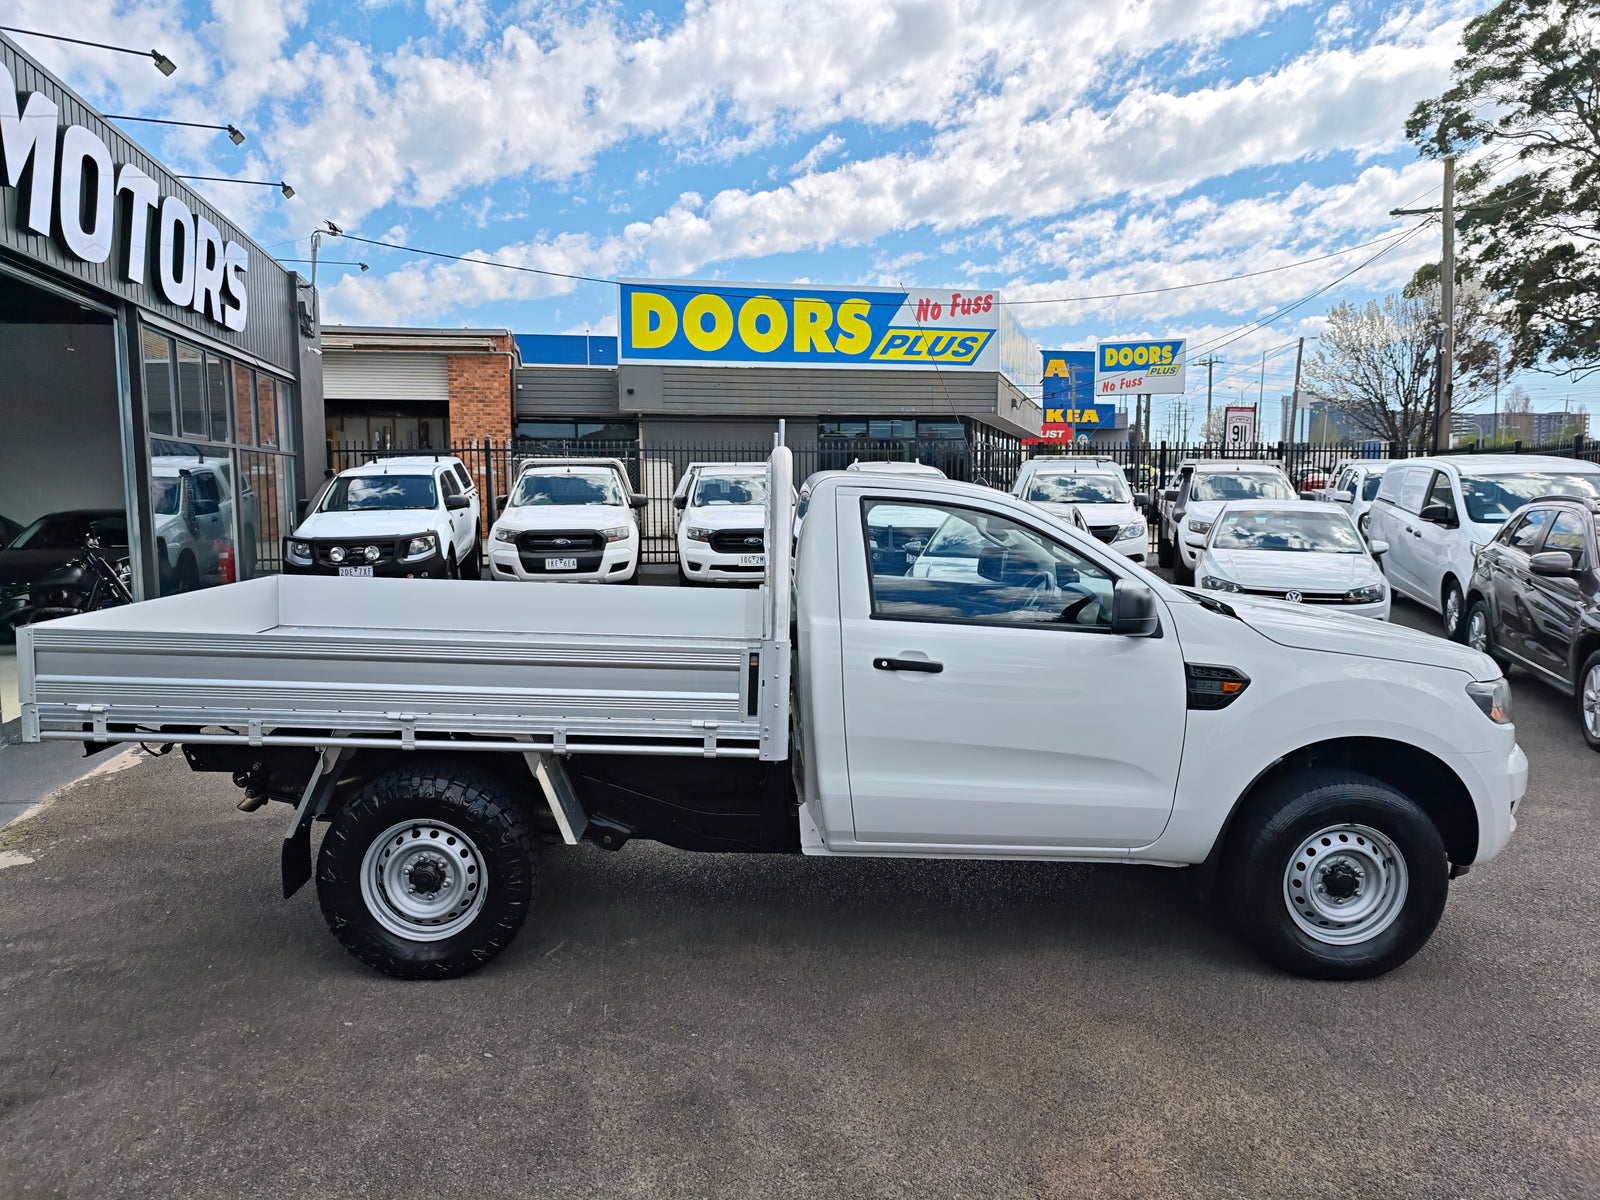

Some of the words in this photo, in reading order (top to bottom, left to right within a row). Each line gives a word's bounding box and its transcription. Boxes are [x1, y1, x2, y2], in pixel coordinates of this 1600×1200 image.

[0, 61, 248, 332] MOTORS
[916, 298, 941, 323] No
[950, 293, 993, 317] Fuss
[631, 292, 872, 355] DOORS
[880, 334, 980, 358] PLUS
[1105, 345, 1172, 367] DOORS
[1150, 366, 1177, 376] PLUS
[1102, 382, 1116, 393] No
[1120, 377, 1143, 388] Fuss
